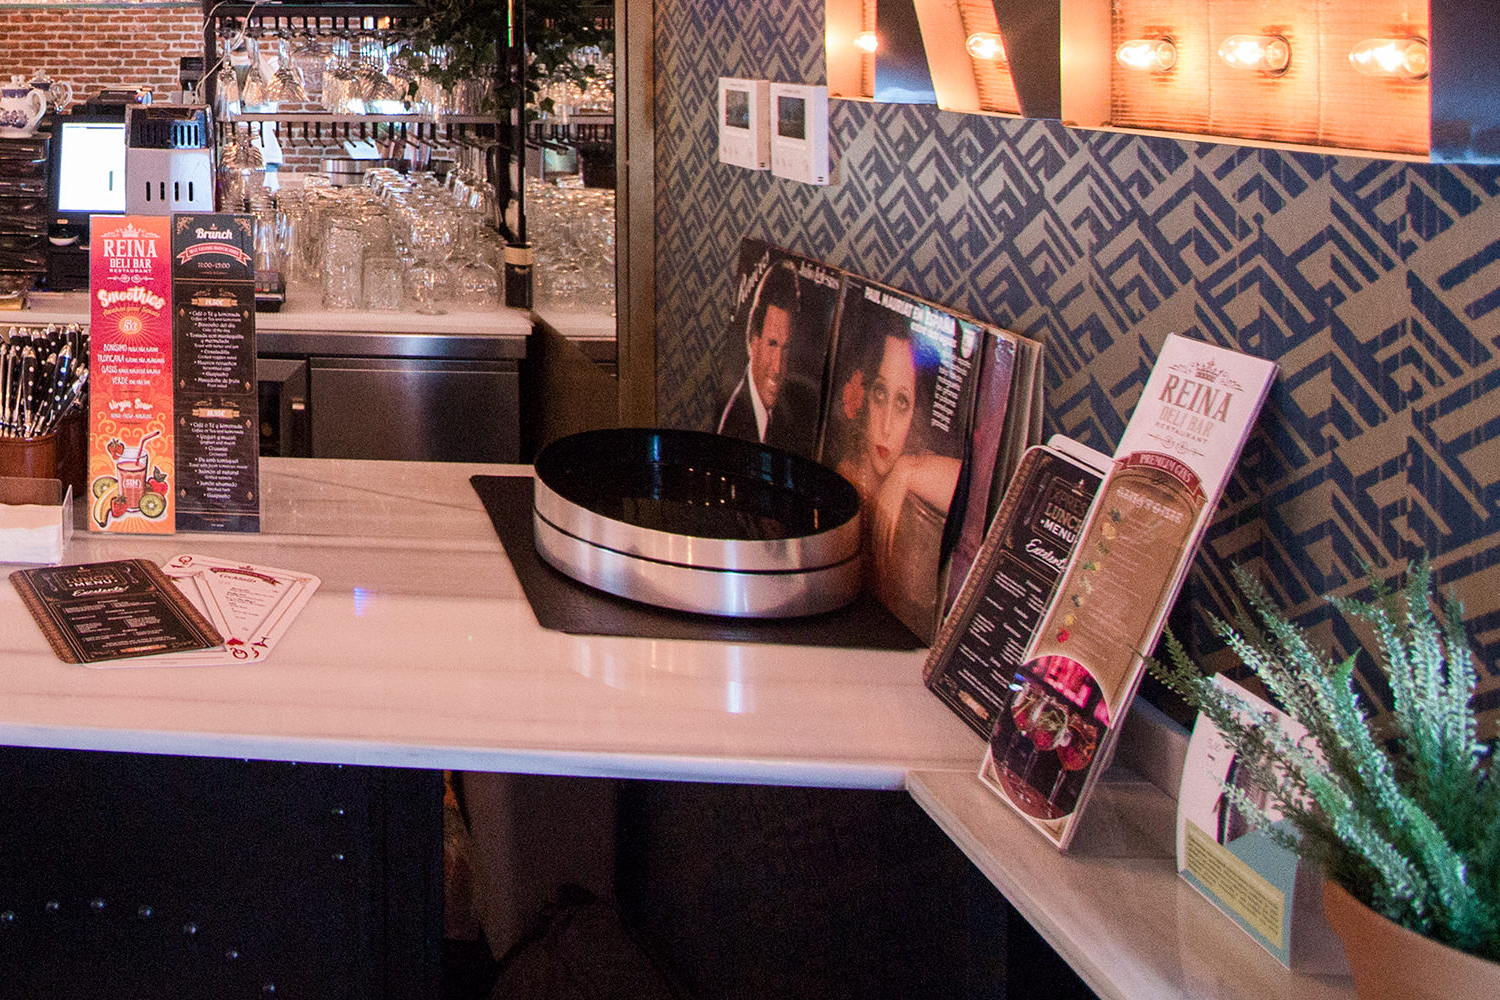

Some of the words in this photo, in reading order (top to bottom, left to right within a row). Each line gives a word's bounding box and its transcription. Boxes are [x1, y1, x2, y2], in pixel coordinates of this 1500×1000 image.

[195, 227, 233, 240] Brunch
[103, 239, 158, 258] REINA
[109, 258, 130, 269] DELI
[133, 258, 152, 269] BAR
[97, 286, 166, 310] Smoothies
[1158, 373, 1233, 422] REINA
[1043, 519, 1077, 543] MENU
[74, 579, 112, 587] MENU
